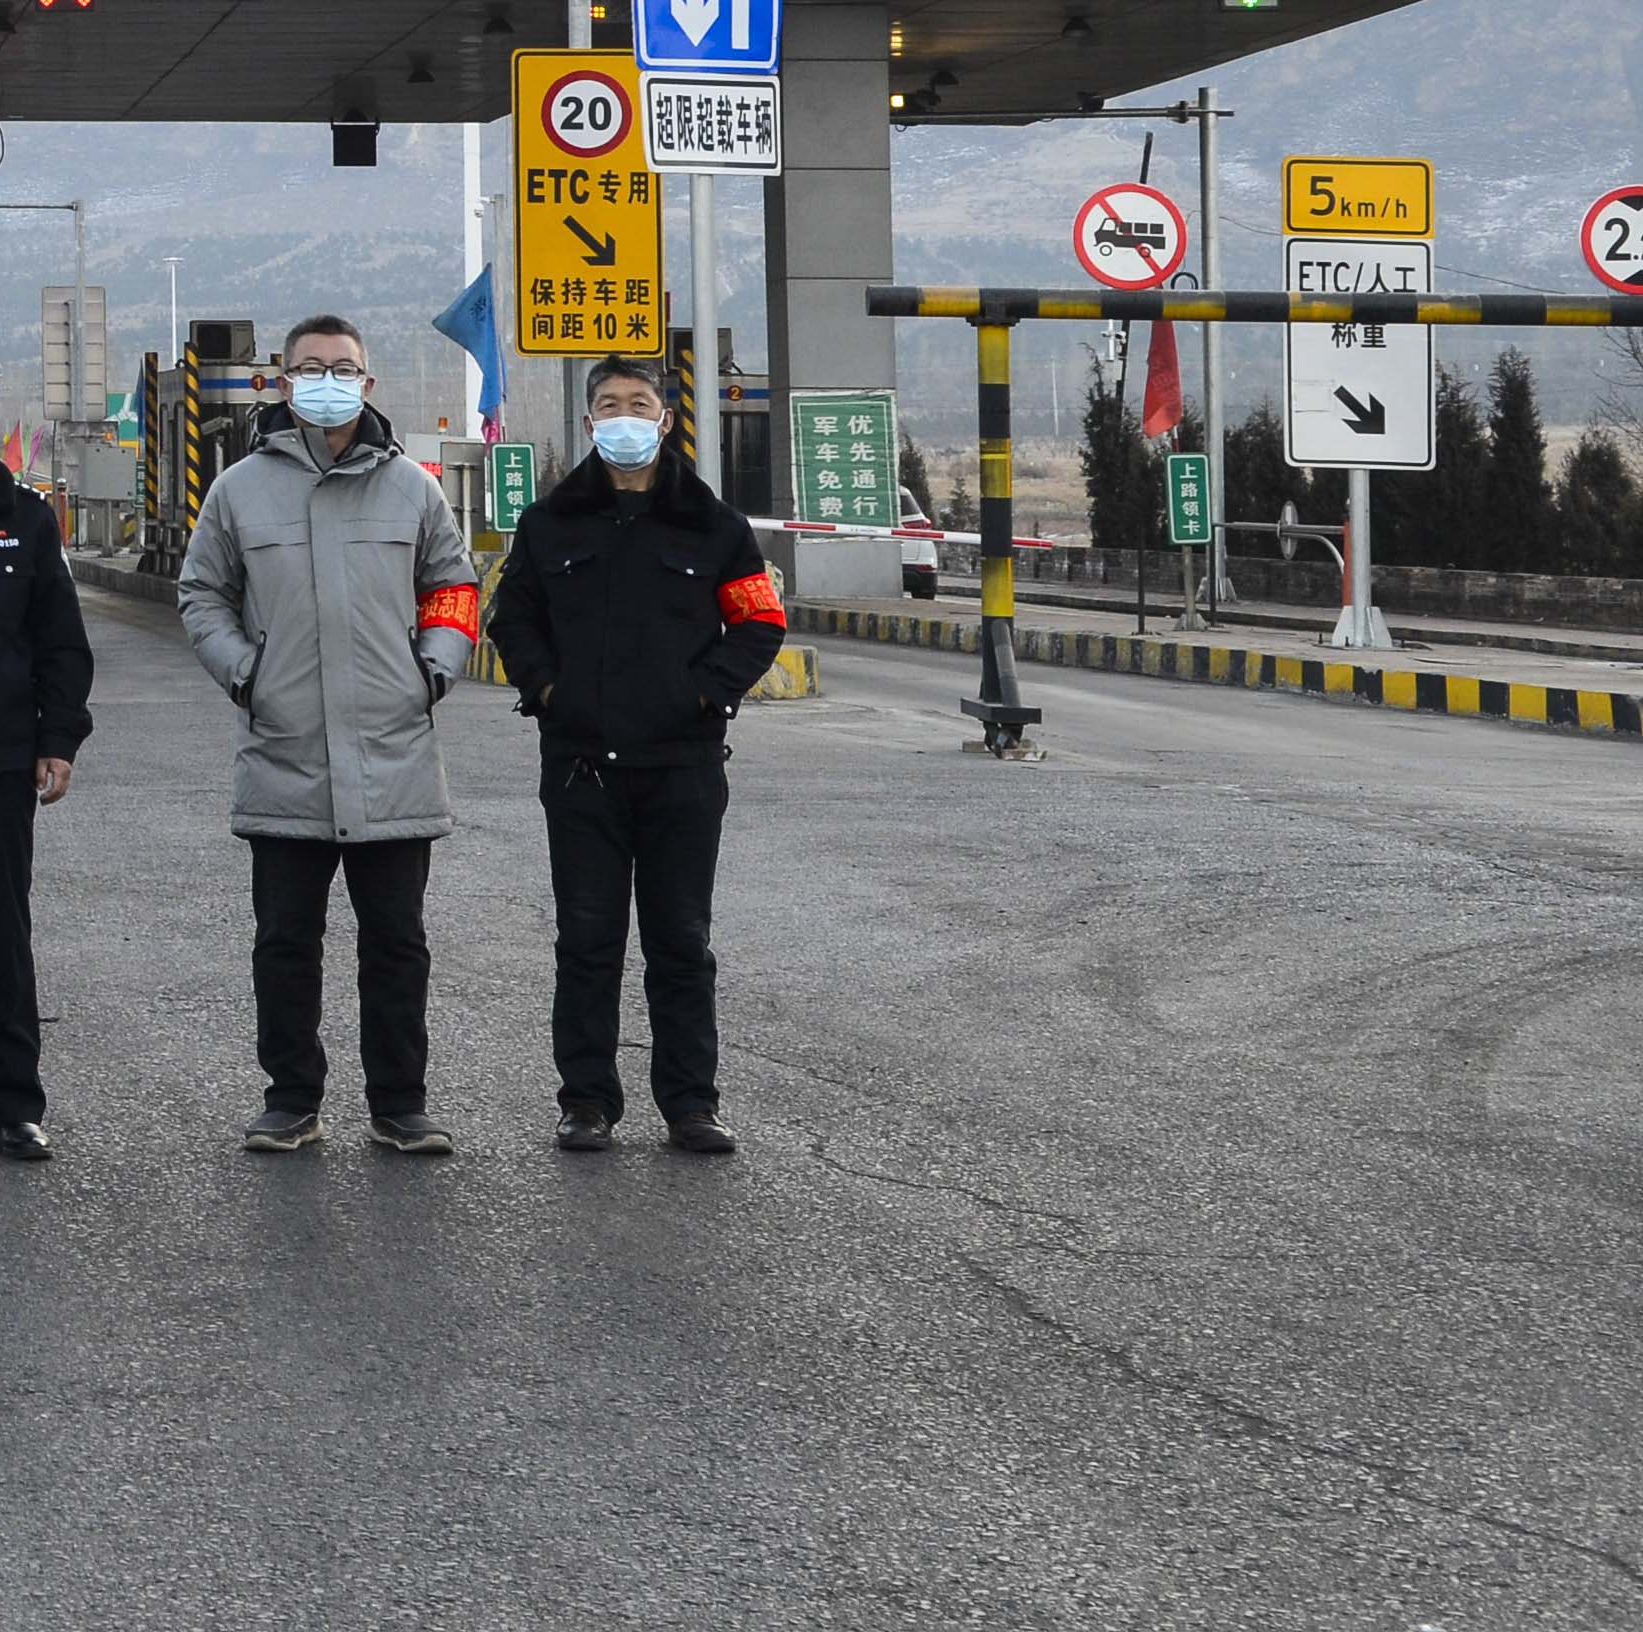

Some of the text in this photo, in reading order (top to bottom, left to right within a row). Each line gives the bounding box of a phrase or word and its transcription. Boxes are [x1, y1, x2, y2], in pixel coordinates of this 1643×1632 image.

[560, 96, 612, 131] 20
[656, 92, 773, 155] 超限超载车辆
[1603, 217, 1643, 261] 2.
[530, 277, 651, 306] 保持车距
[1298, 260, 1417, 293] ETC/人工
[531, 313, 650, 341] 间距10米
[1331, 321, 1387, 349] 称重
[812, 415, 844, 518] 军车免费
[847, 414, 879, 517] 优先通行
[504, 452, 524, 524] 上路领卡
[1179, 462, 1201, 536] 上路领卡
